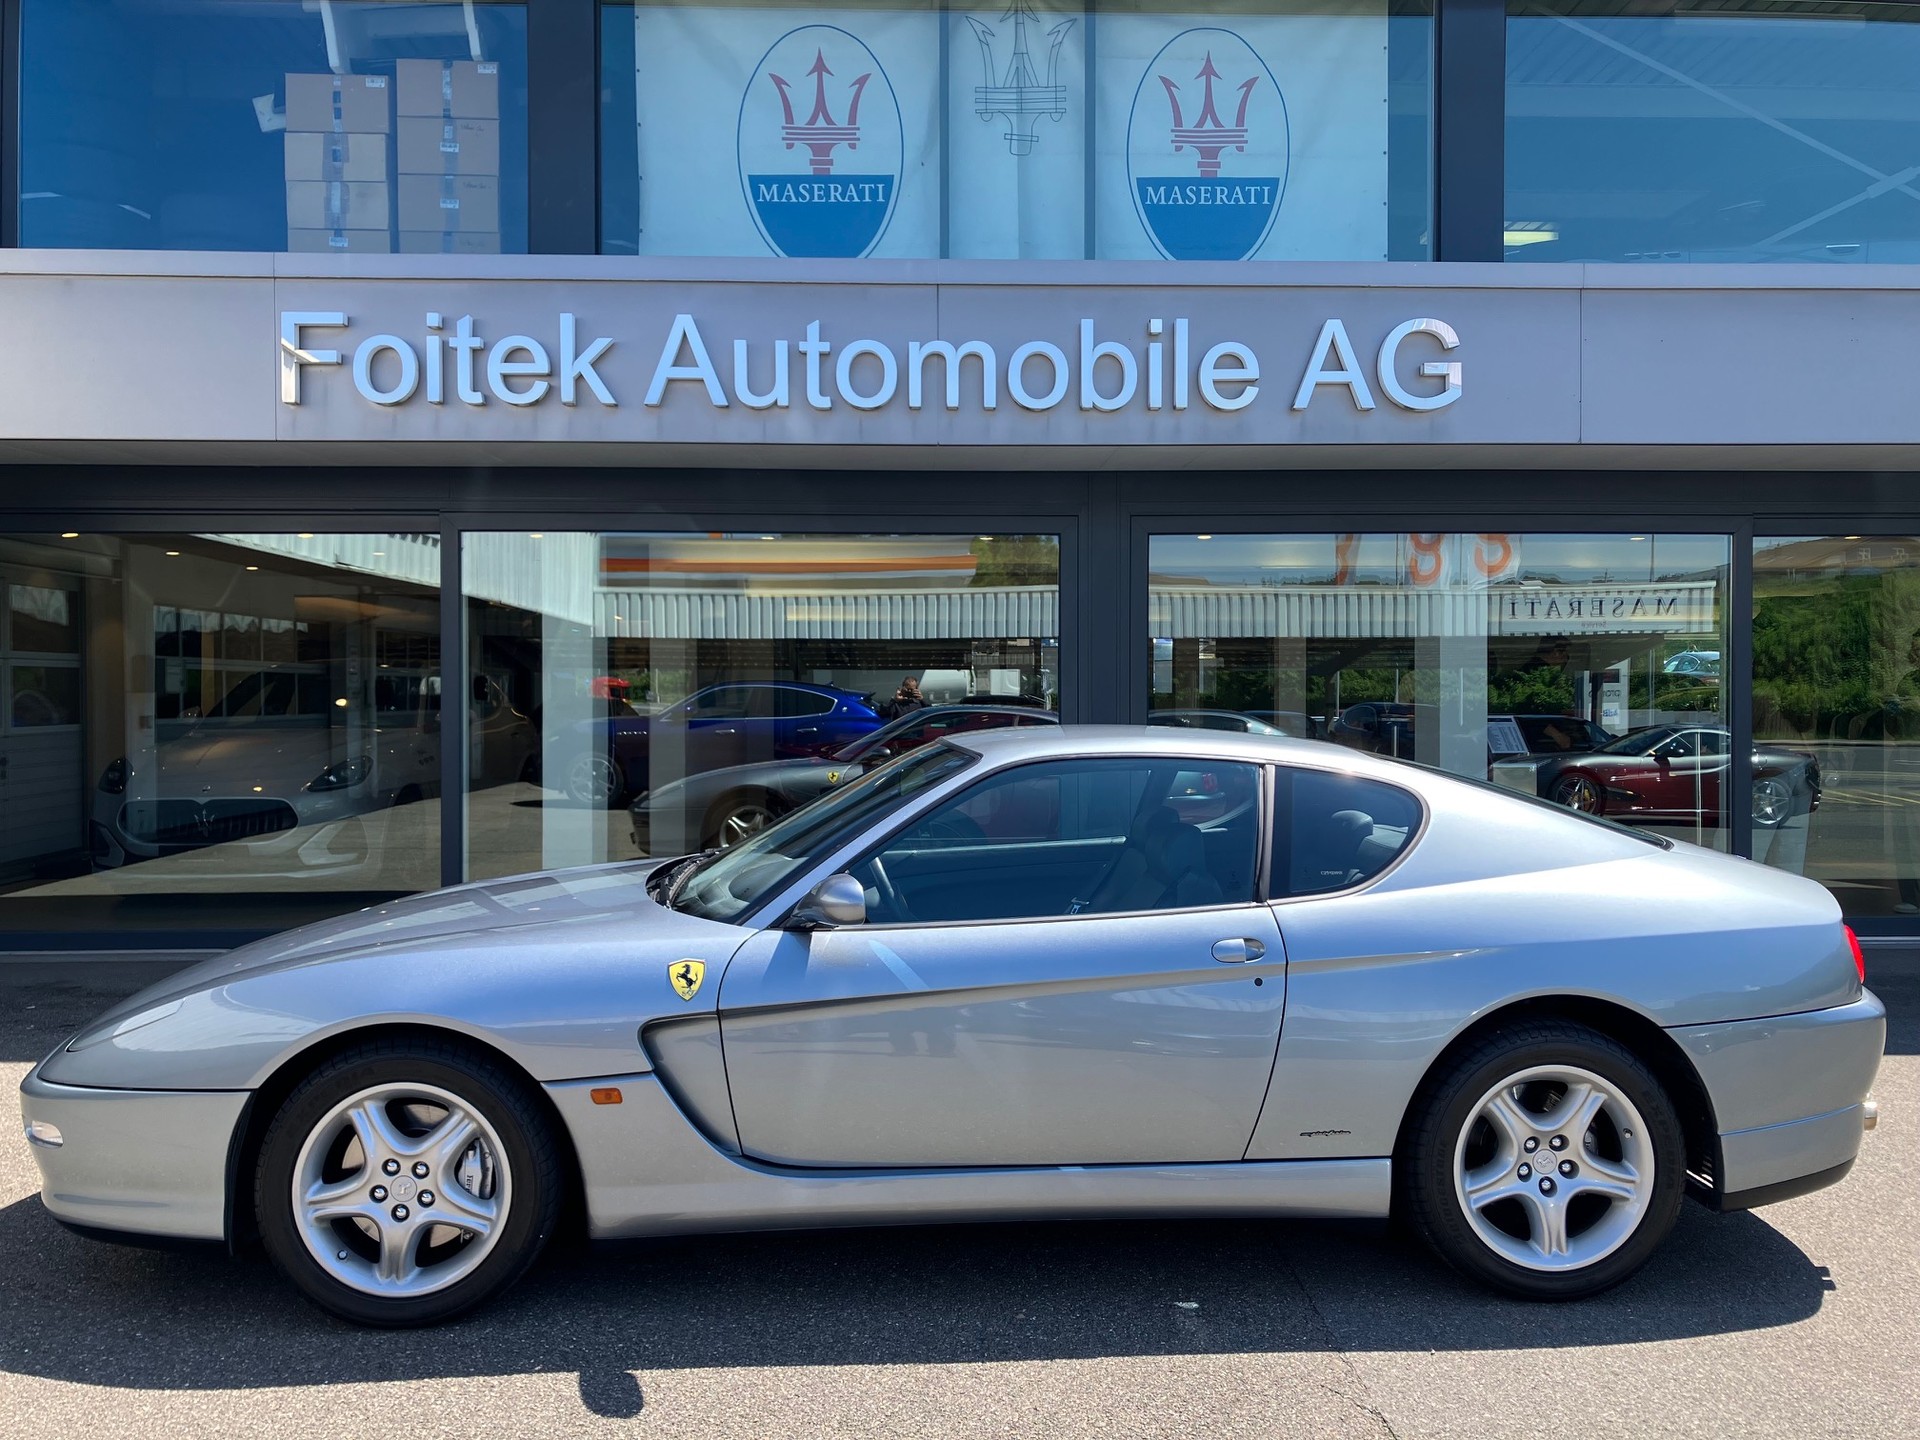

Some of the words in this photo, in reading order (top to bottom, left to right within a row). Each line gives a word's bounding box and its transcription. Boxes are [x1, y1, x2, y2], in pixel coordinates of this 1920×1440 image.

[757, 183, 886, 203] MASERATI
[1146, 186, 1271, 205] MASERATI
[281, 311, 618, 407] Foitek
[644, 313, 1261, 412] Automobile
[1291, 317, 1463, 412] AG
